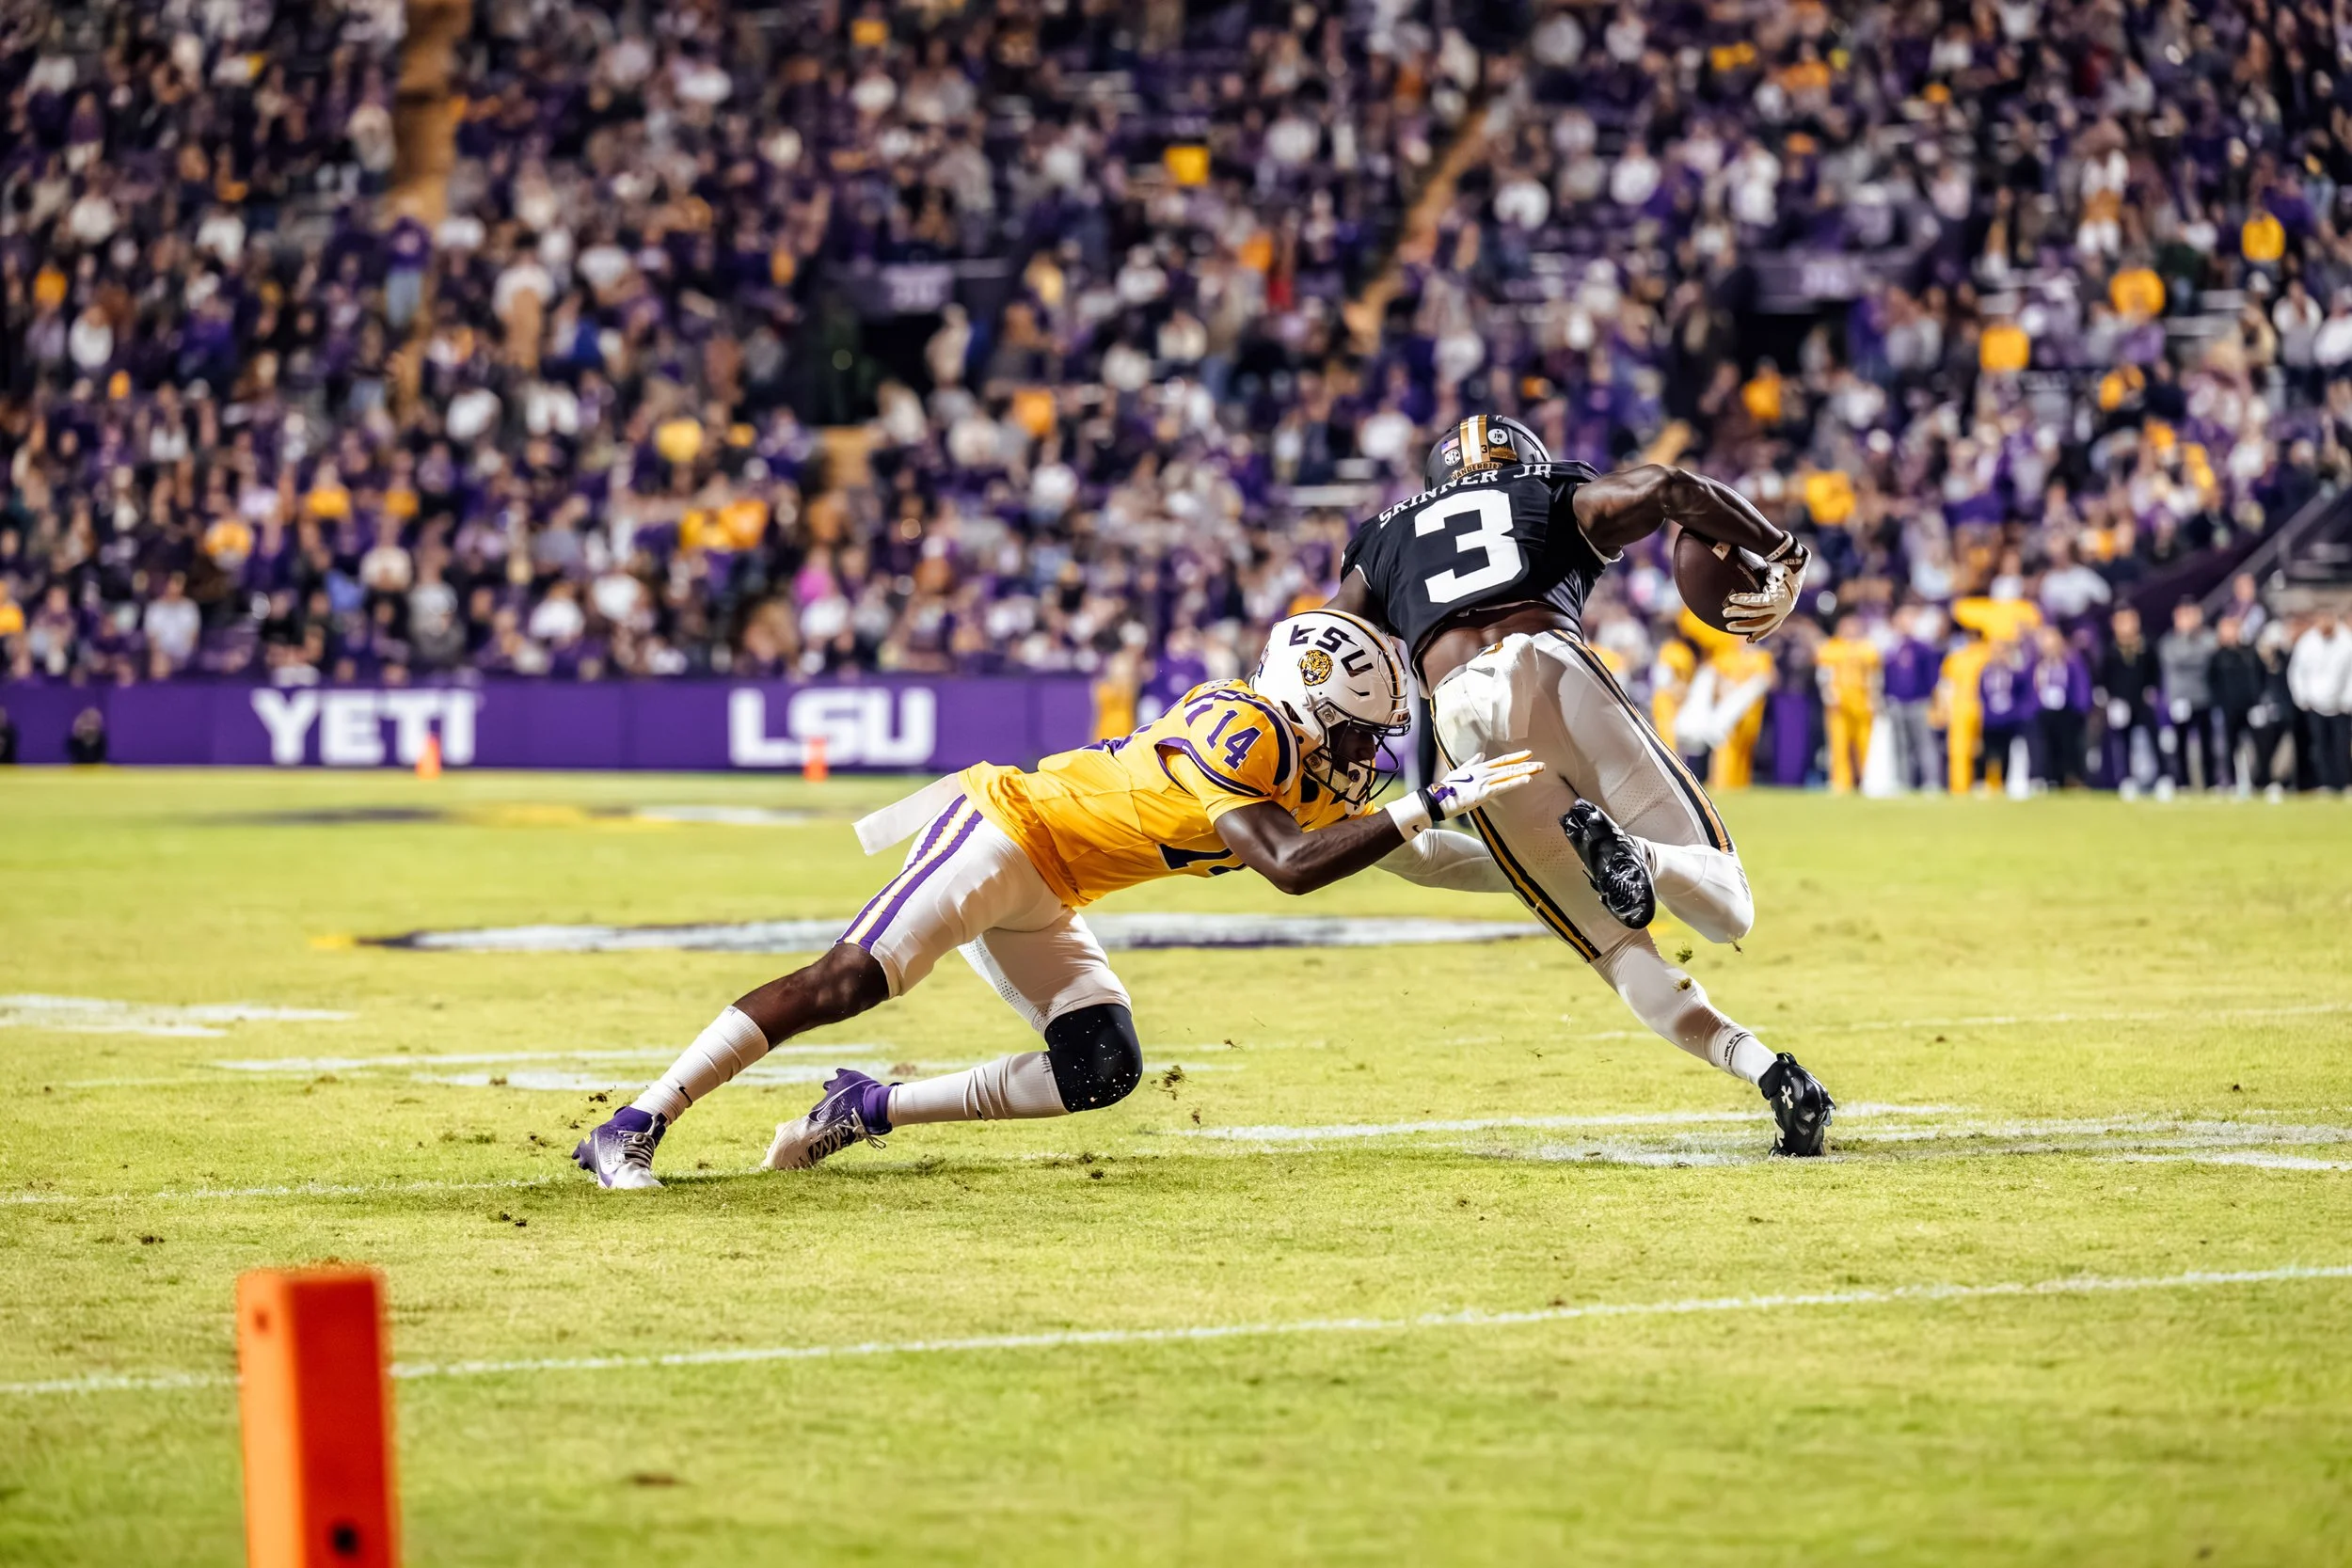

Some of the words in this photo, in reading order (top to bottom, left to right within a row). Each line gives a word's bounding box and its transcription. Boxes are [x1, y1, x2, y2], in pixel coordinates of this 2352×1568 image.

[1481, 444, 1488, 453] 3
[1378, 469, 1499, 530] SKINNER
[1513, 464, 1551, 479] JR
[1414, 489, 1522, 603] 3
[251, 689, 477, 766] YETI
[728, 688, 937, 767] LSU
[1206, 709, 1263, 770] 14
